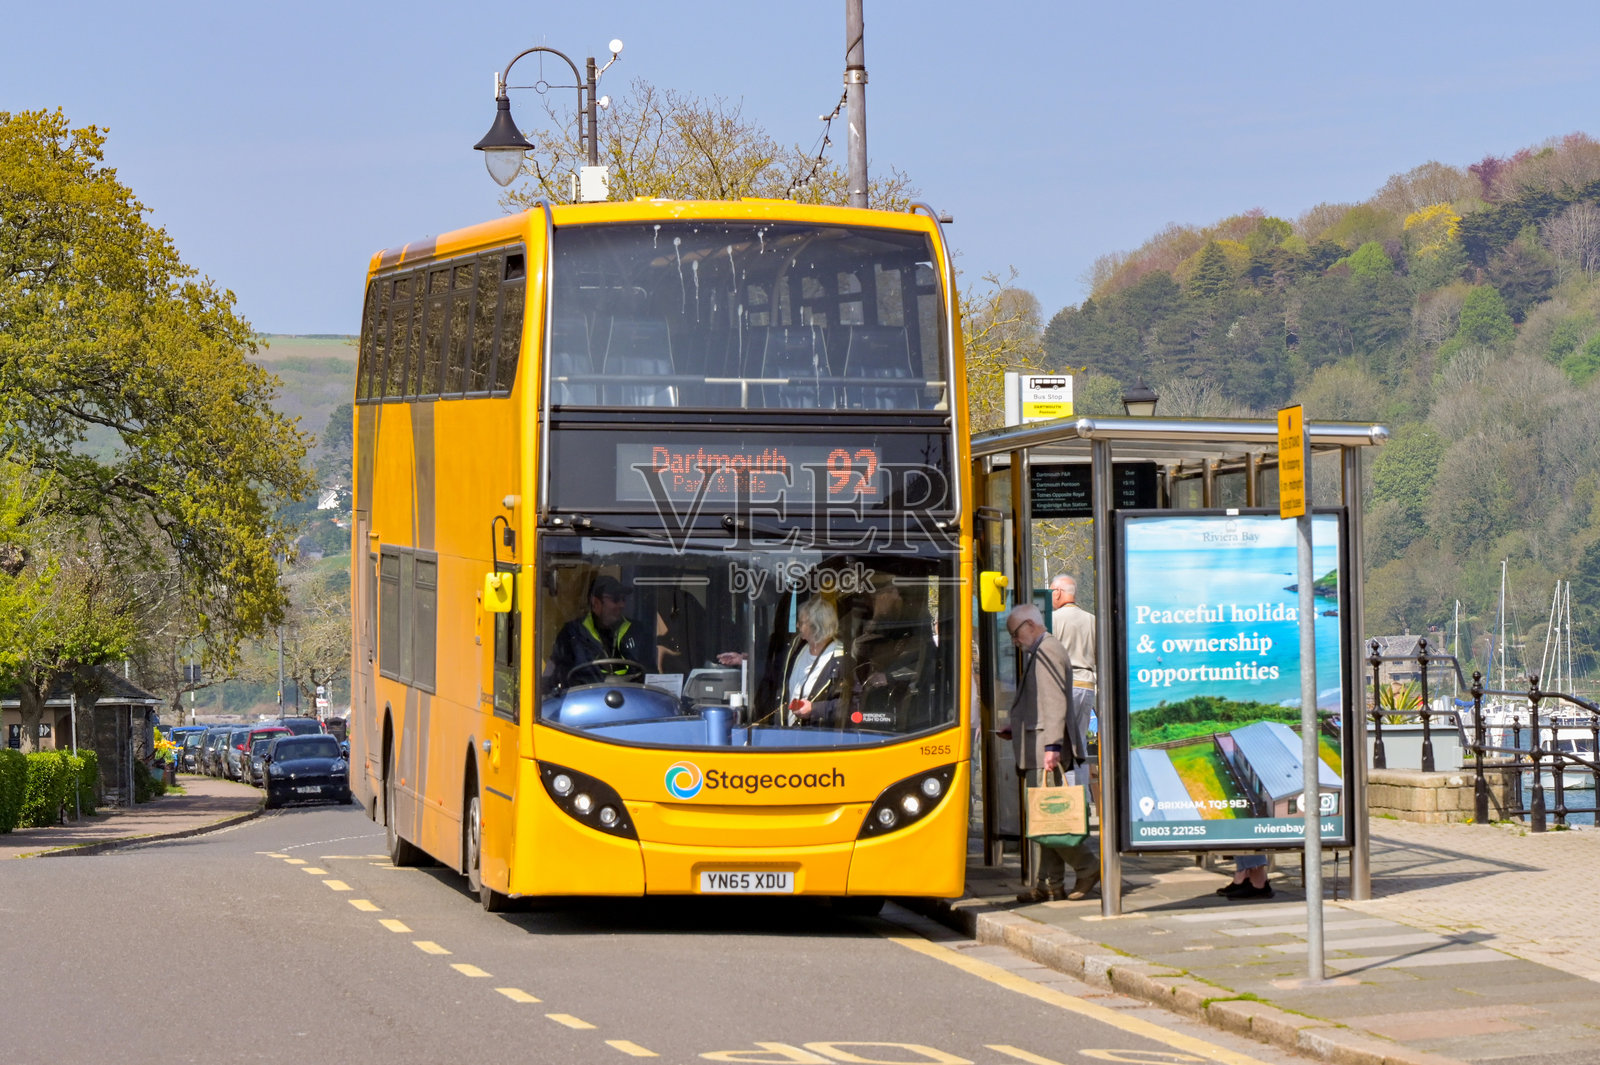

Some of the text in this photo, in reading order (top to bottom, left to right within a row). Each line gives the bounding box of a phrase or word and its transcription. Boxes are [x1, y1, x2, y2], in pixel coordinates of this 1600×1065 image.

[652, 446, 877, 494] Dartmouth 92
[1203, 531, 1260, 543] Riviera Bay
[1135, 602, 1319, 626] Peaceful holidas
[1136, 632, 1273, 656] & ownership
[1137, 661, 1280, 687] opportunities
[920, 745, 951, 755] 15255
[705, 768, 845, 793] Stagecoach
[1157, 801, 1206, 810] BRIXHAM,
[1208, 800, 1228, 810] TQ5
[1140, 825, 1207, 836] 01803 221255
[707, 873, 788, 889] YN65 XDU
